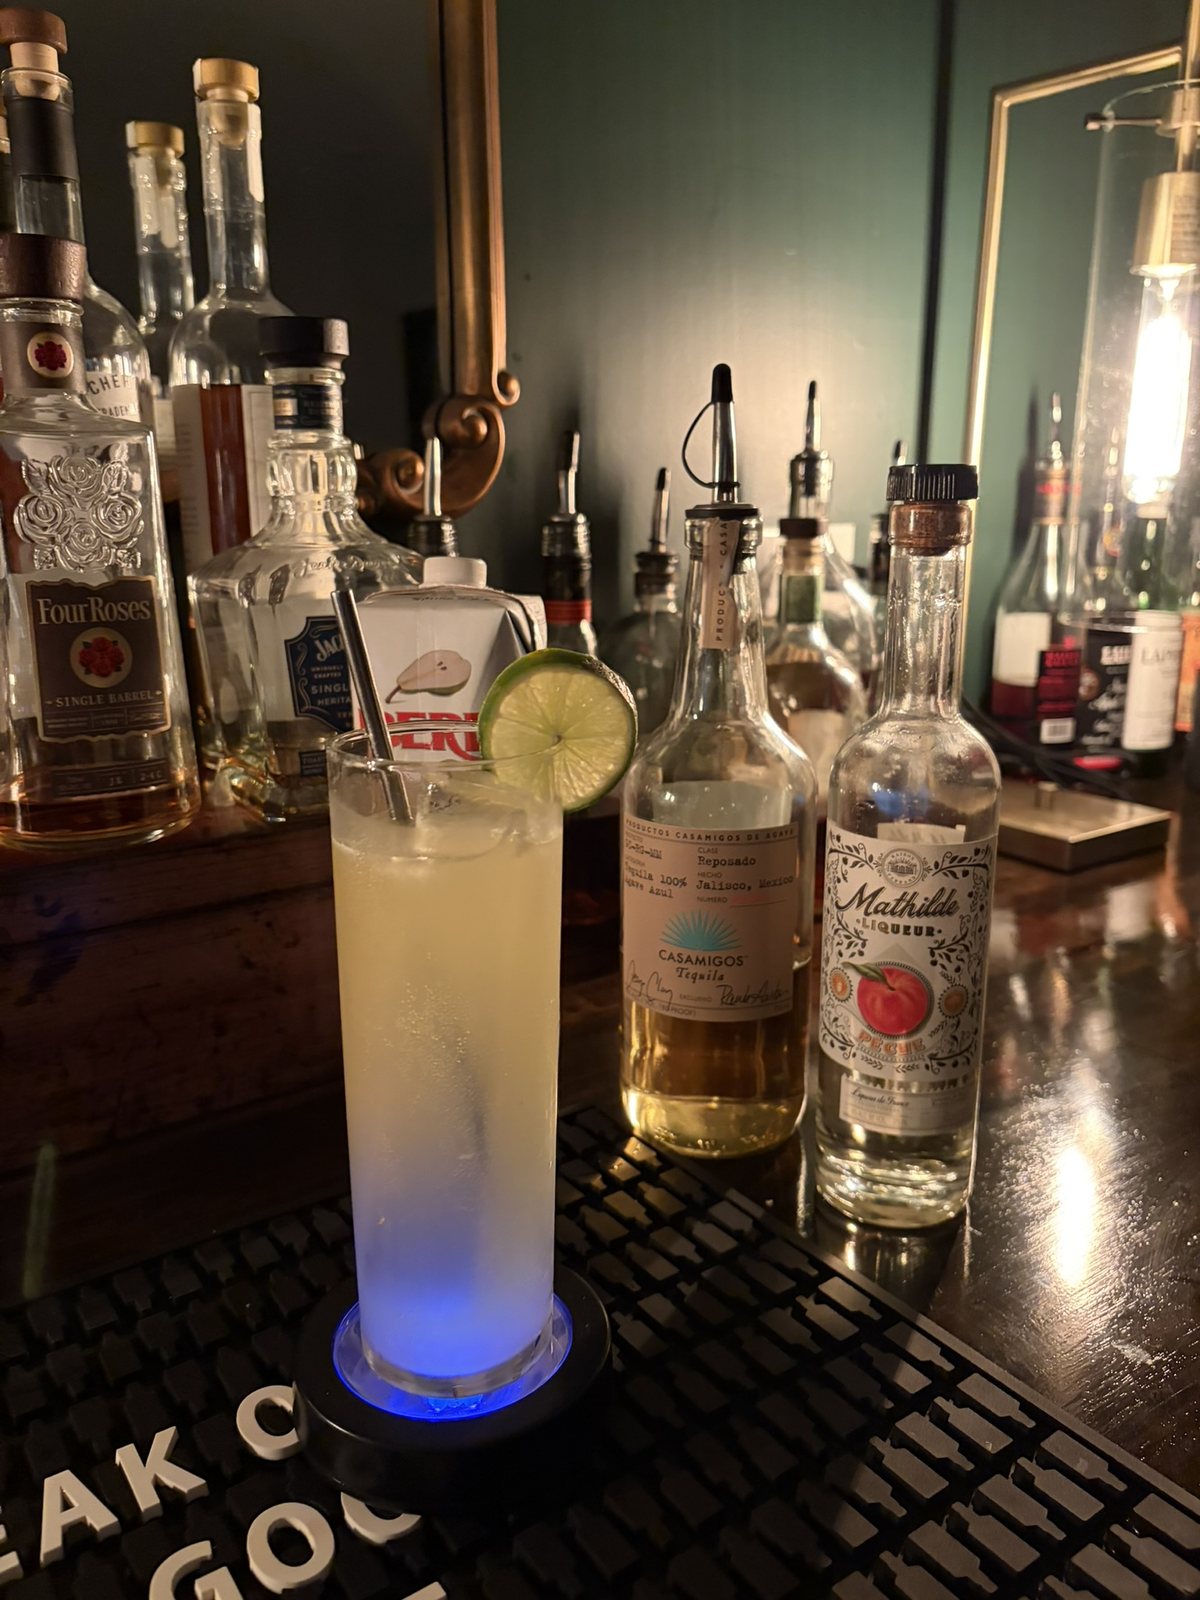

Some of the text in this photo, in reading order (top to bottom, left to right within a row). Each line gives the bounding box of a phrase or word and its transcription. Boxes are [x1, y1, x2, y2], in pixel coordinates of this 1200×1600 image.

[37, 596, 152, 625] Four Roses
[311, 683, 350, 695] SINGL
[56, 690, 153, 708] SINGLE BARREL
[317, 697, 352, 707] HERITA
[675, 831, 741, 842] CASAMIGOS
[697, 855, 757, 868] Reposado
[660, 874, 688, 888] 100%
[696, 875, 794, 892] Jalisco, Mexico
[834, 881, 961, 919] Mathilde
[861, 917, 936, 937] LIQUEUR
[658, 949, 745, 967] CASAMIGOS
[675, 966, 725, 984] Tequila
